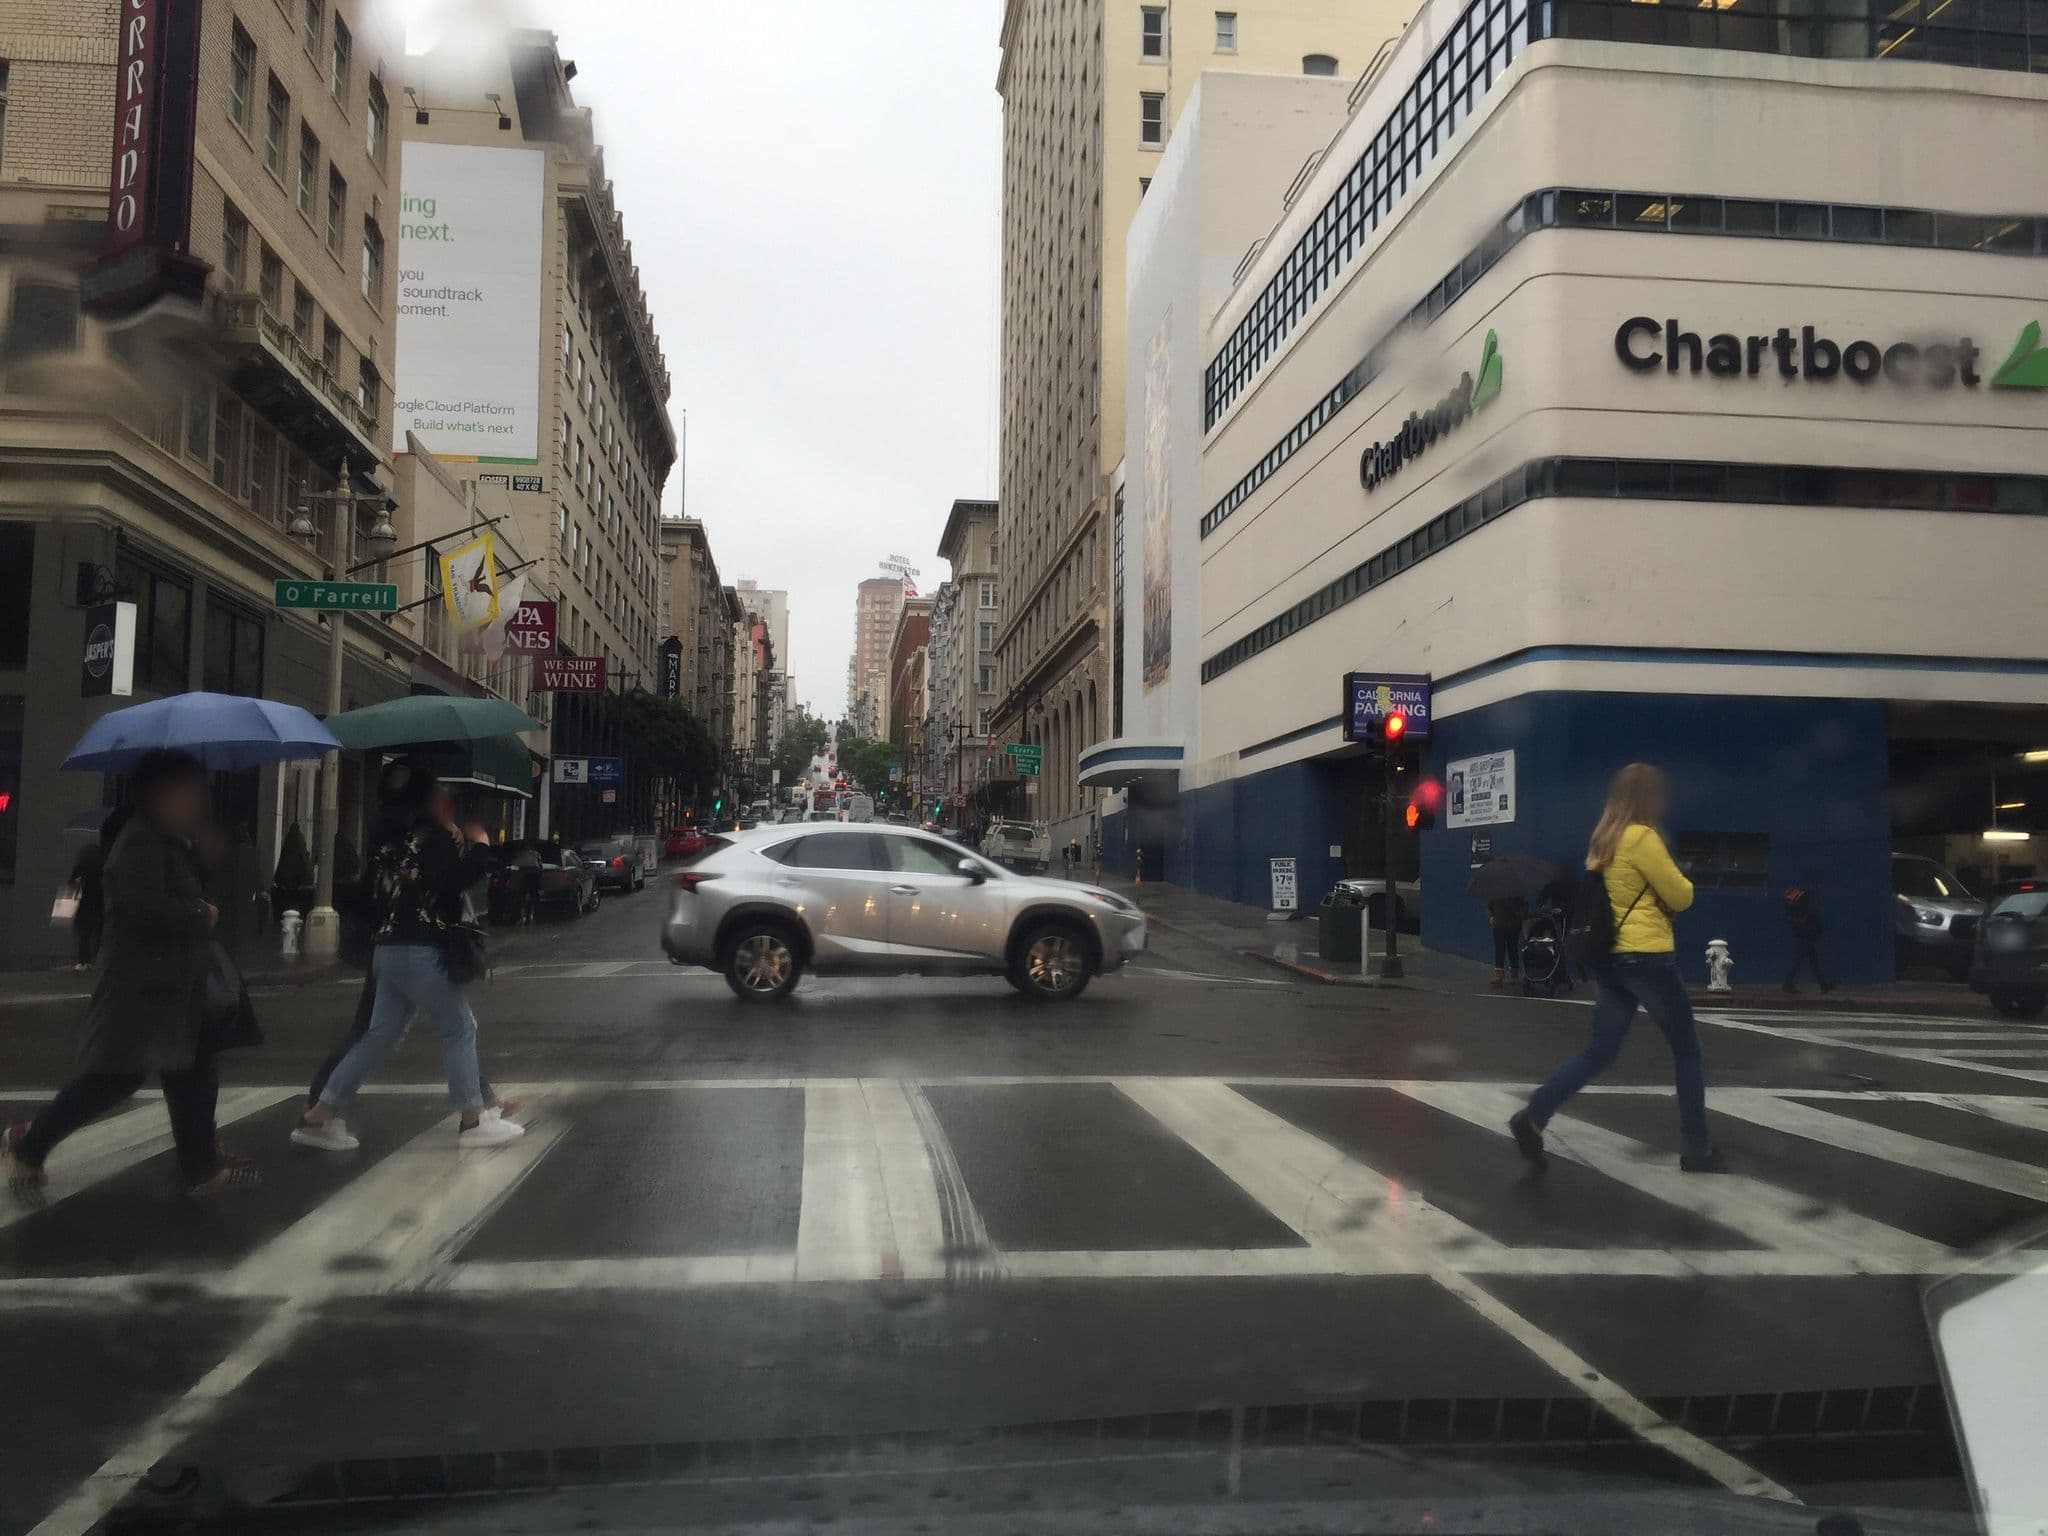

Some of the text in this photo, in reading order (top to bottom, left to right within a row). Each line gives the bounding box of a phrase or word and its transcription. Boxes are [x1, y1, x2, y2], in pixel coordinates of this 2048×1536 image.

[117, 0, 146, 232] RRANO
[400, 191, 436, 218] ing
[401, 223, 454, 242] next.
[399, 269, 424, 283] you
[403, 286, 483, 302] soundtrack
[1614, 316, 1980, 386] Chartboost
[425, 400, 461, 412] Cloud
[463, 402, 515, 416] Platform
[414, 418, 514, 435] Build what's next
[286, 586, 387, 605] O'Farrell
[544, 660, 597, 671] WE SHIP
[544, 672, 597, 688] WINE
[1357, 689, 1422, 702] CALIFORNIA
[1013, 746, 1034, 755] Geary
